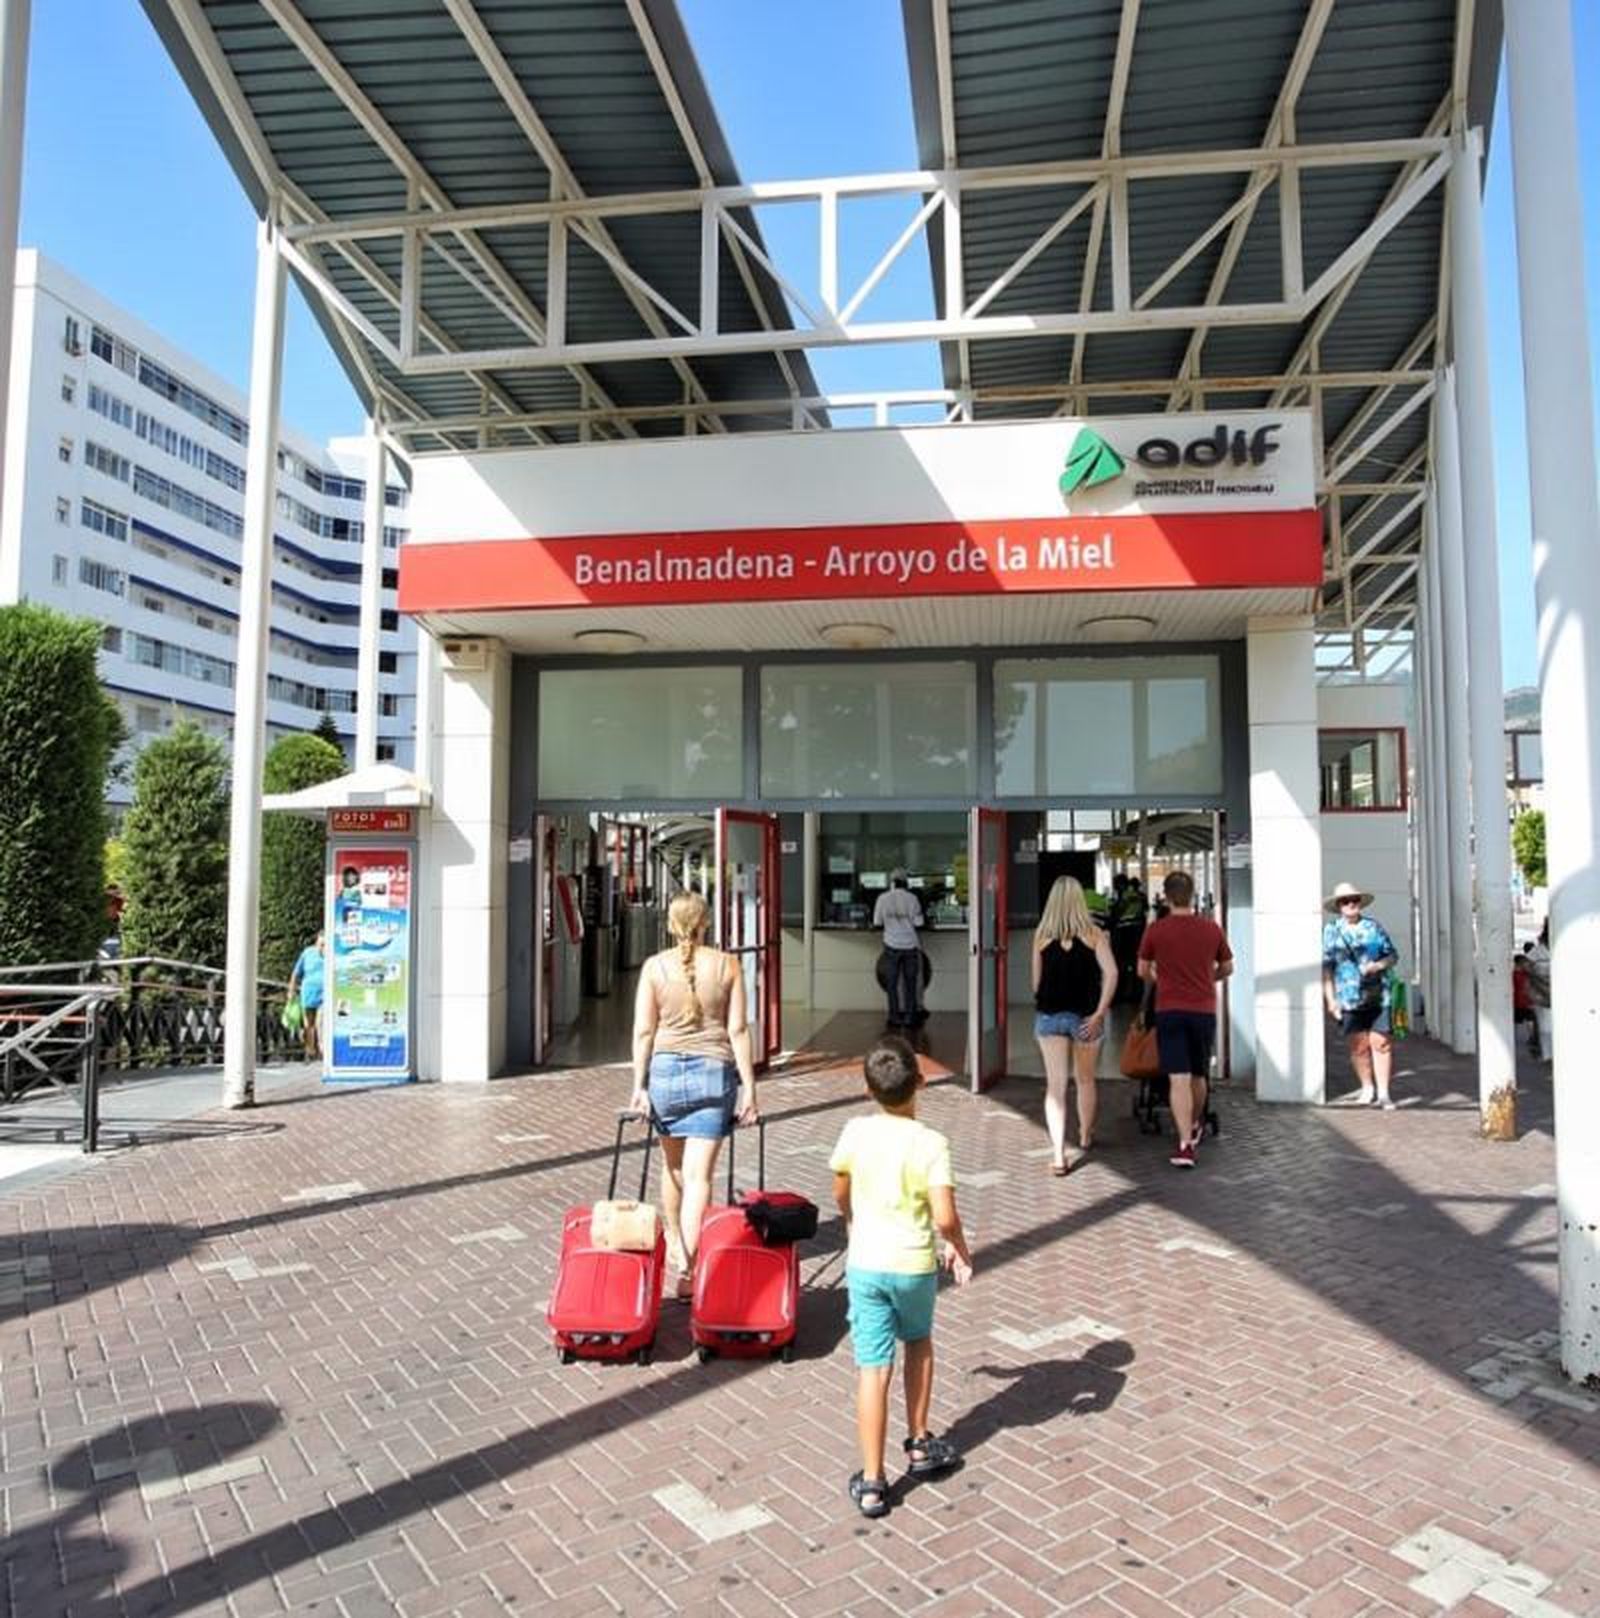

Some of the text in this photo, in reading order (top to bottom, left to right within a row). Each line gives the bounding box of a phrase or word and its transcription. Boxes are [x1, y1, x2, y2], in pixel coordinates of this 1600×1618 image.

[1136, 424, 1282, 469] adif
[575, 547, 794, 585] Benalmadena
[824, 546, 936, 582] Arroyo
[947, 539, 987, 572] de
[997, 537, 1028, 571] la
[1038, 533, 1114, 570] Miel
[334, 812, 376, 822] FOTOS
